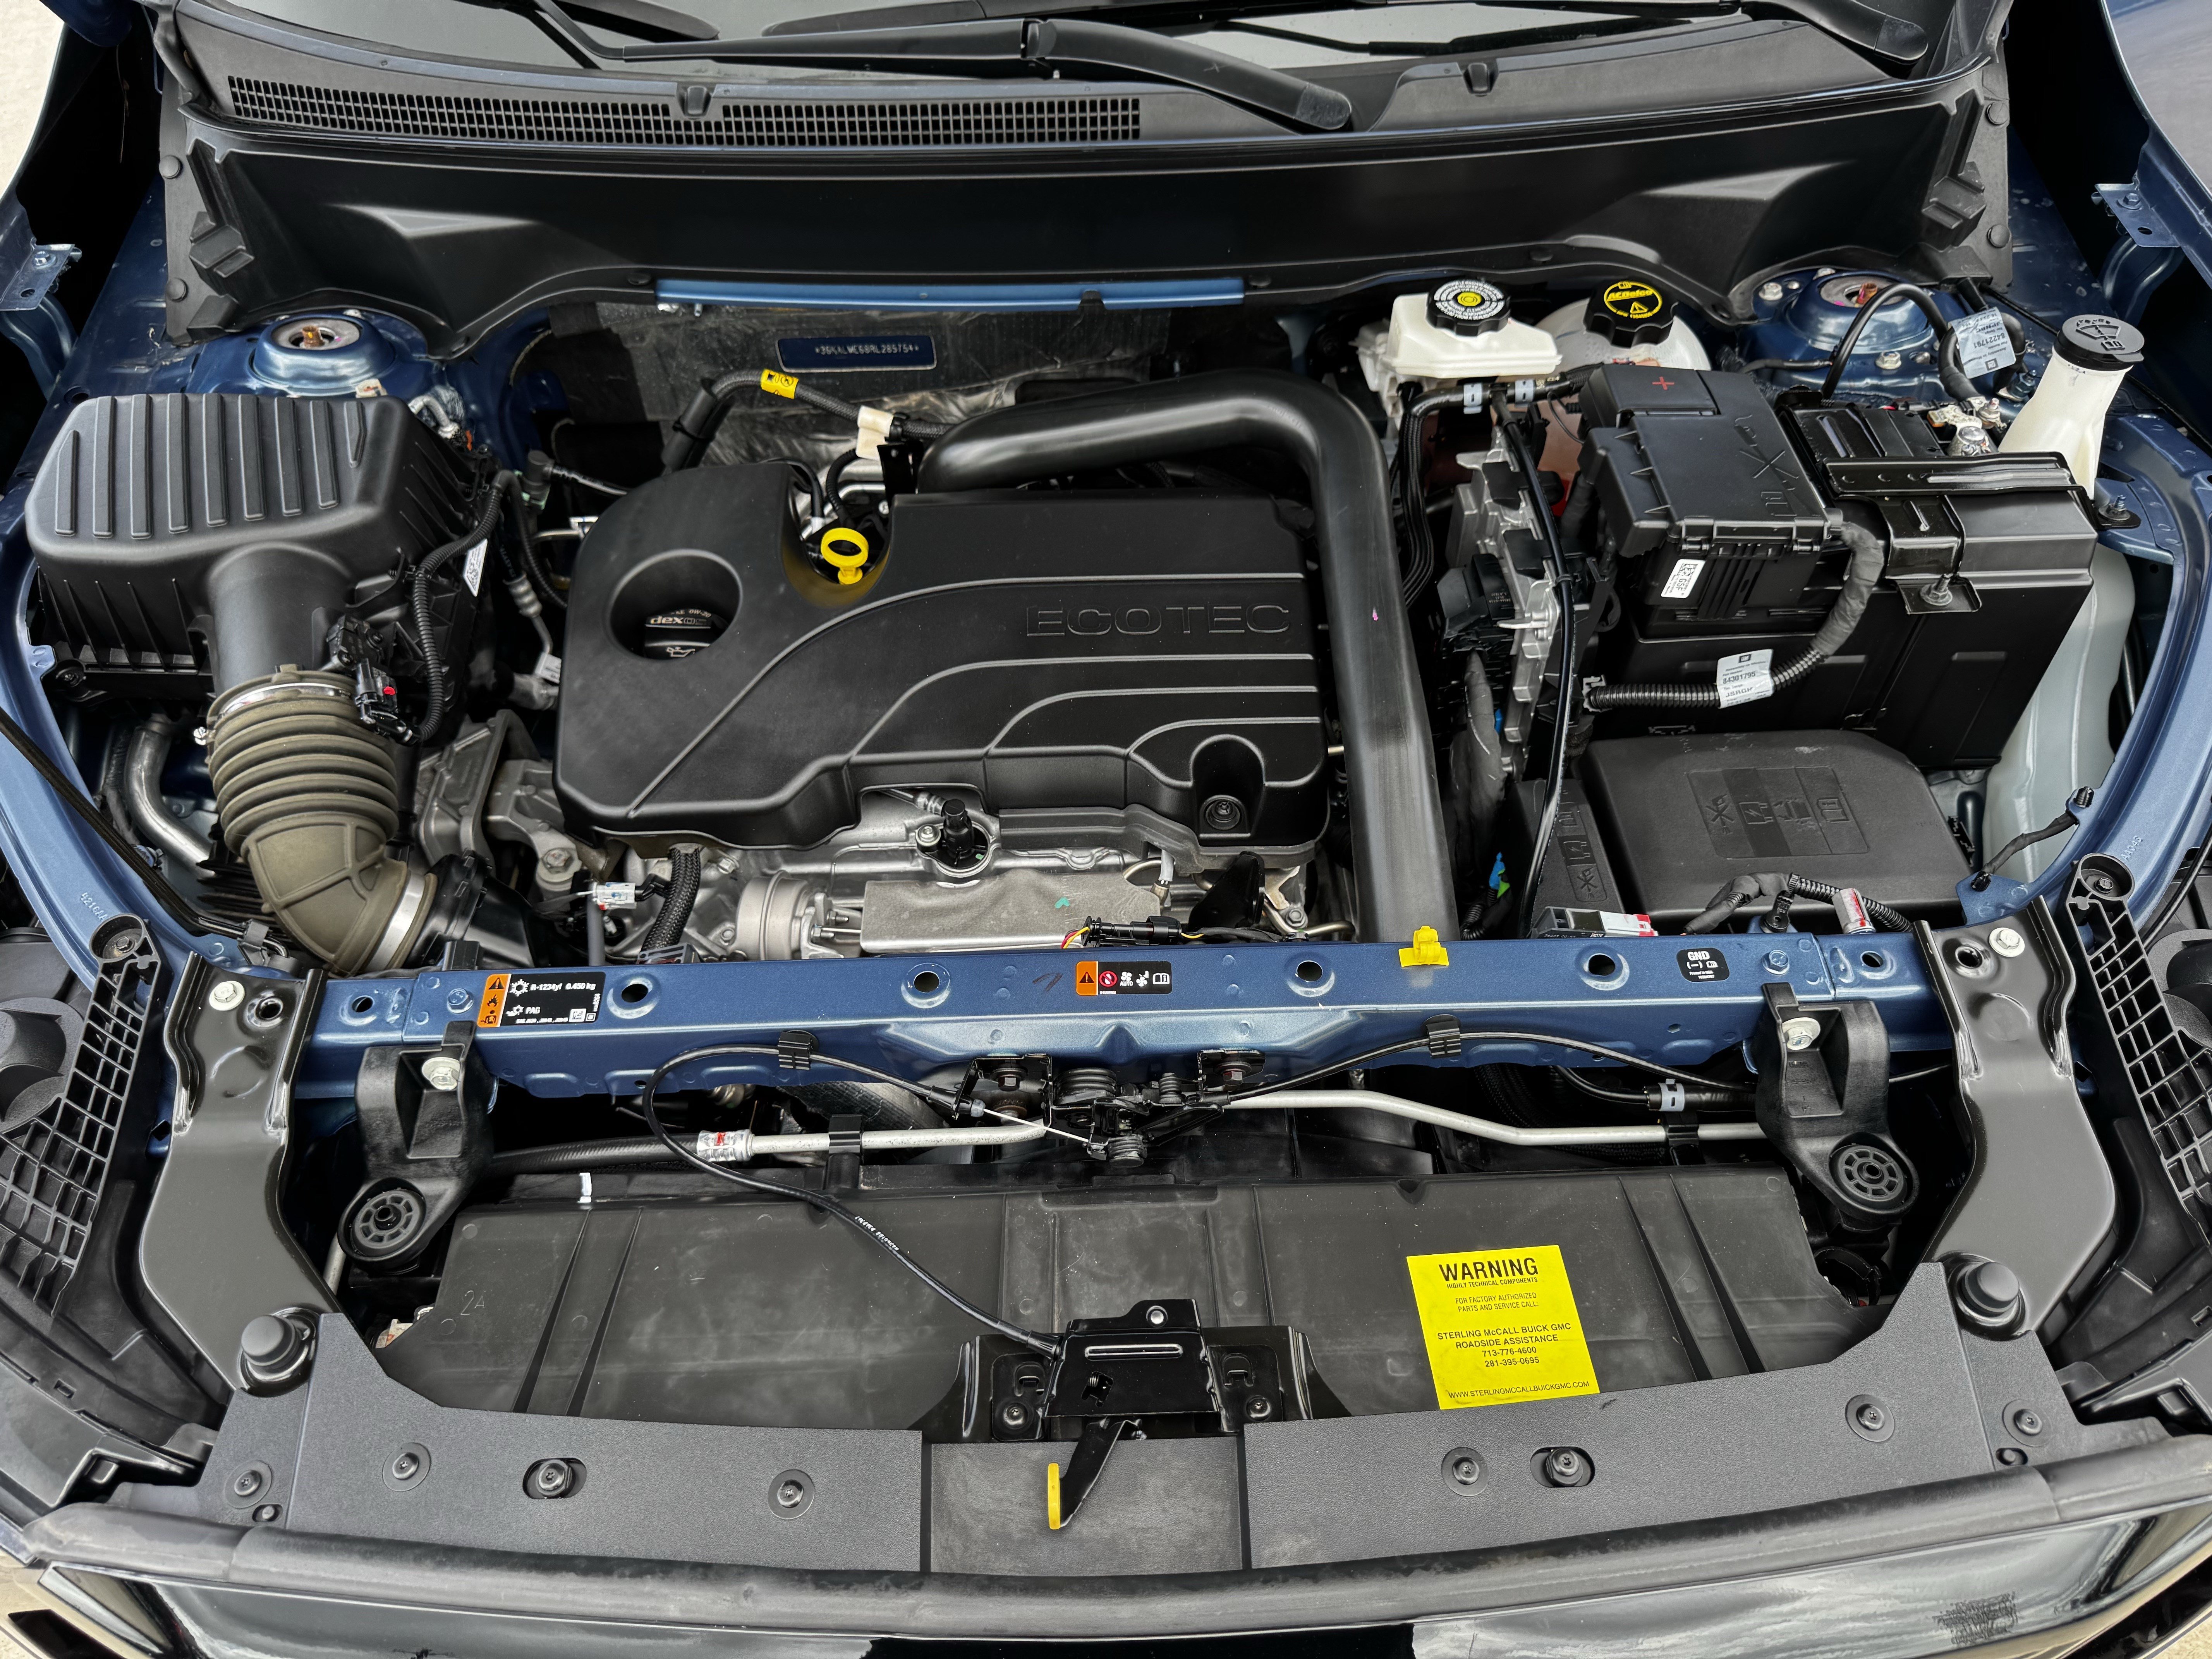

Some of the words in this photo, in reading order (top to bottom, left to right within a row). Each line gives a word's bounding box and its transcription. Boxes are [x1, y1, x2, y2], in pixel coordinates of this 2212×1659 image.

[1973, 333, 2005, 349] 84221791
[1026, 604, 1290, 637] ECOTEC
[1723, 671, 1756, 684] 84301795
[1687, 951, 1710, 961] GND
[530, 983, 562, 991] R-1234yf
[1439, 1257, 1538, 1281] WARNING
[1500, 1277, 1538, 1285] COMPONENTS
[1499, 1292, 1537, 1301] AUTHORIZED
[1437, 1329, 1482, 1340] STERLING
[1484, 1327, 1520, 1336] McCALL
[1521, 1324, 1549, 1334] BUICK
[1551, 1323, 1571, 1331] GMC
[1455, 1339, 1501, 1349] ROADSIDE
[1504, 1334, 1559, 1345] ASSISTANCE
[1482, 1346, 1537, 1357] 713-776-4600
[1484, 1357, 1540, 1367] 281-395-0695
[1448, 1381, 1590, 1399] WWW.STERLINGMCCALLBUICKGMC.COM
